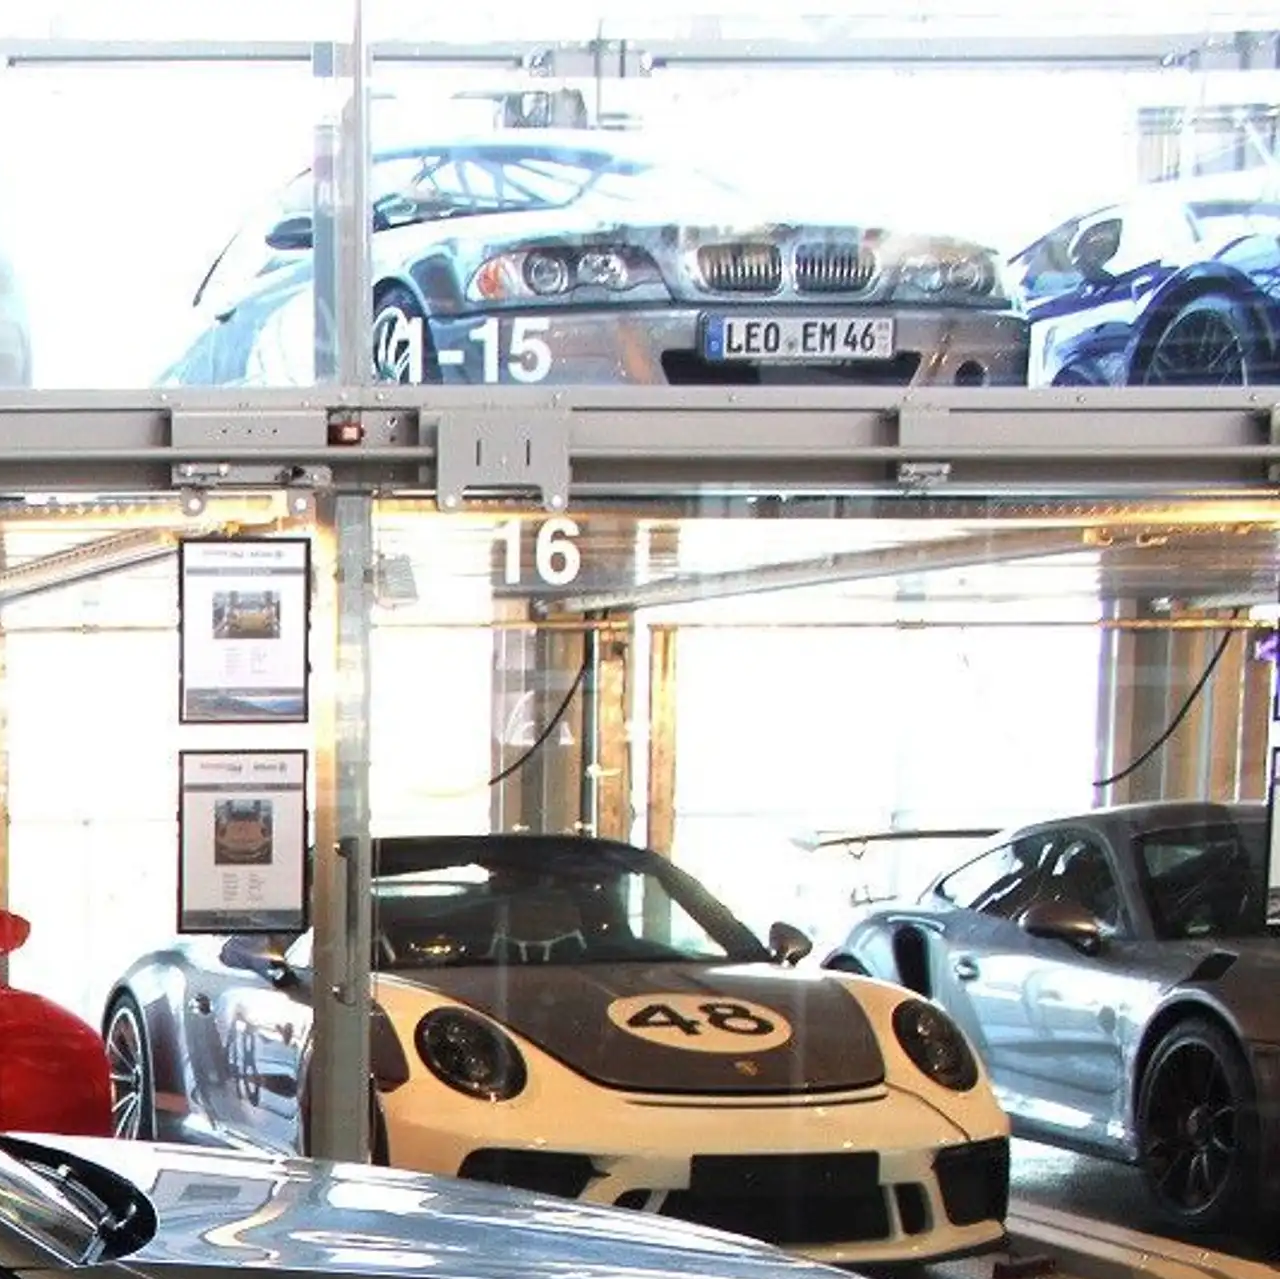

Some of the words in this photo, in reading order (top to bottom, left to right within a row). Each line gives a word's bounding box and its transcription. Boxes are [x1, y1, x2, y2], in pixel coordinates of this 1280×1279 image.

[726, 321, 780, 352] LEO
[802, 321, 837, 352] EM
[843, 321, 876, 352] 46
[626, 1002, 775, 1037] 48
